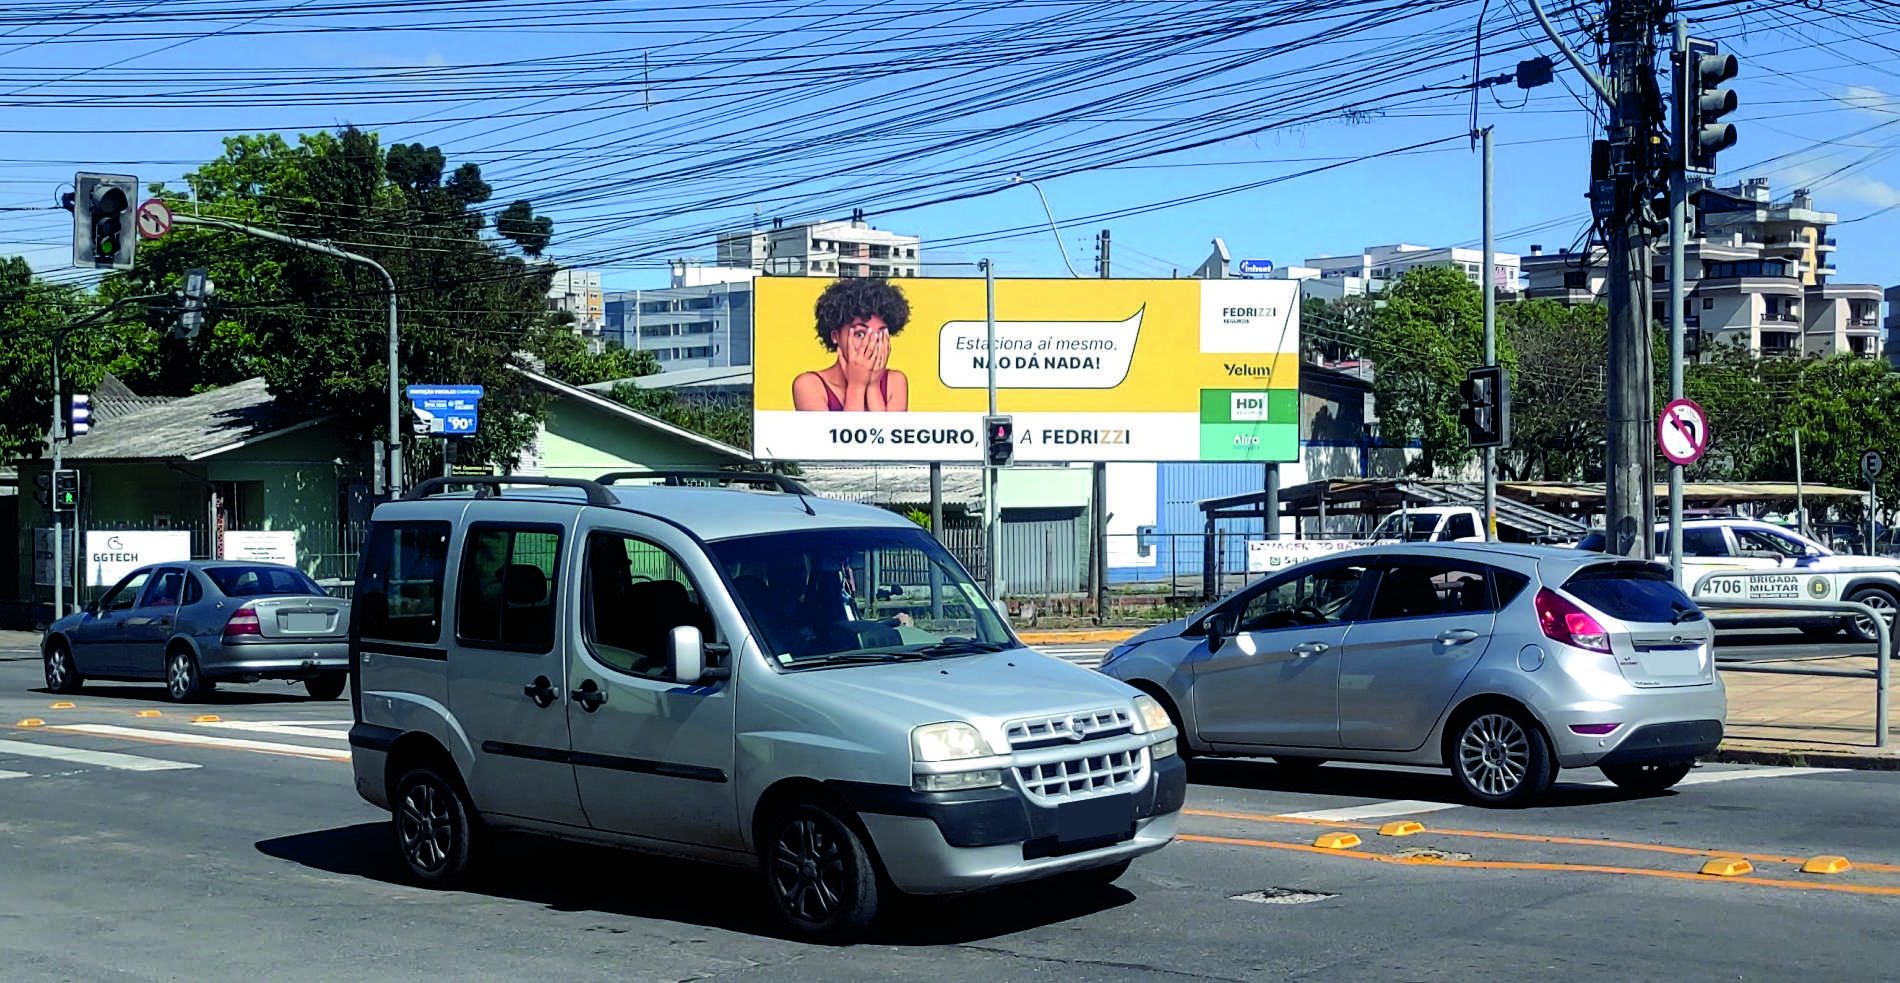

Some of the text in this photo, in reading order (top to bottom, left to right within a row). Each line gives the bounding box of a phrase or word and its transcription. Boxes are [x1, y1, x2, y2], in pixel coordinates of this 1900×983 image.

[1223, 307, 1276, 317] FEDRIZZI
[1037, 336, 1053, 350] aí
[1056, 339, 1118, 350] mesmo.
[1015, 353, 1039, 369] DÁ
[1044, 357, 1100, 369] NADA!
[1224, 363, 1271, 376] Yelum
[1236, 398, 1263, 409] HDI
[829, 429, 1130, 447] 100% SEGURO, A FEDRIZZI
[93, 552, 138, 562] GGTECH
[1702, 580, 1742, 594] 4706
